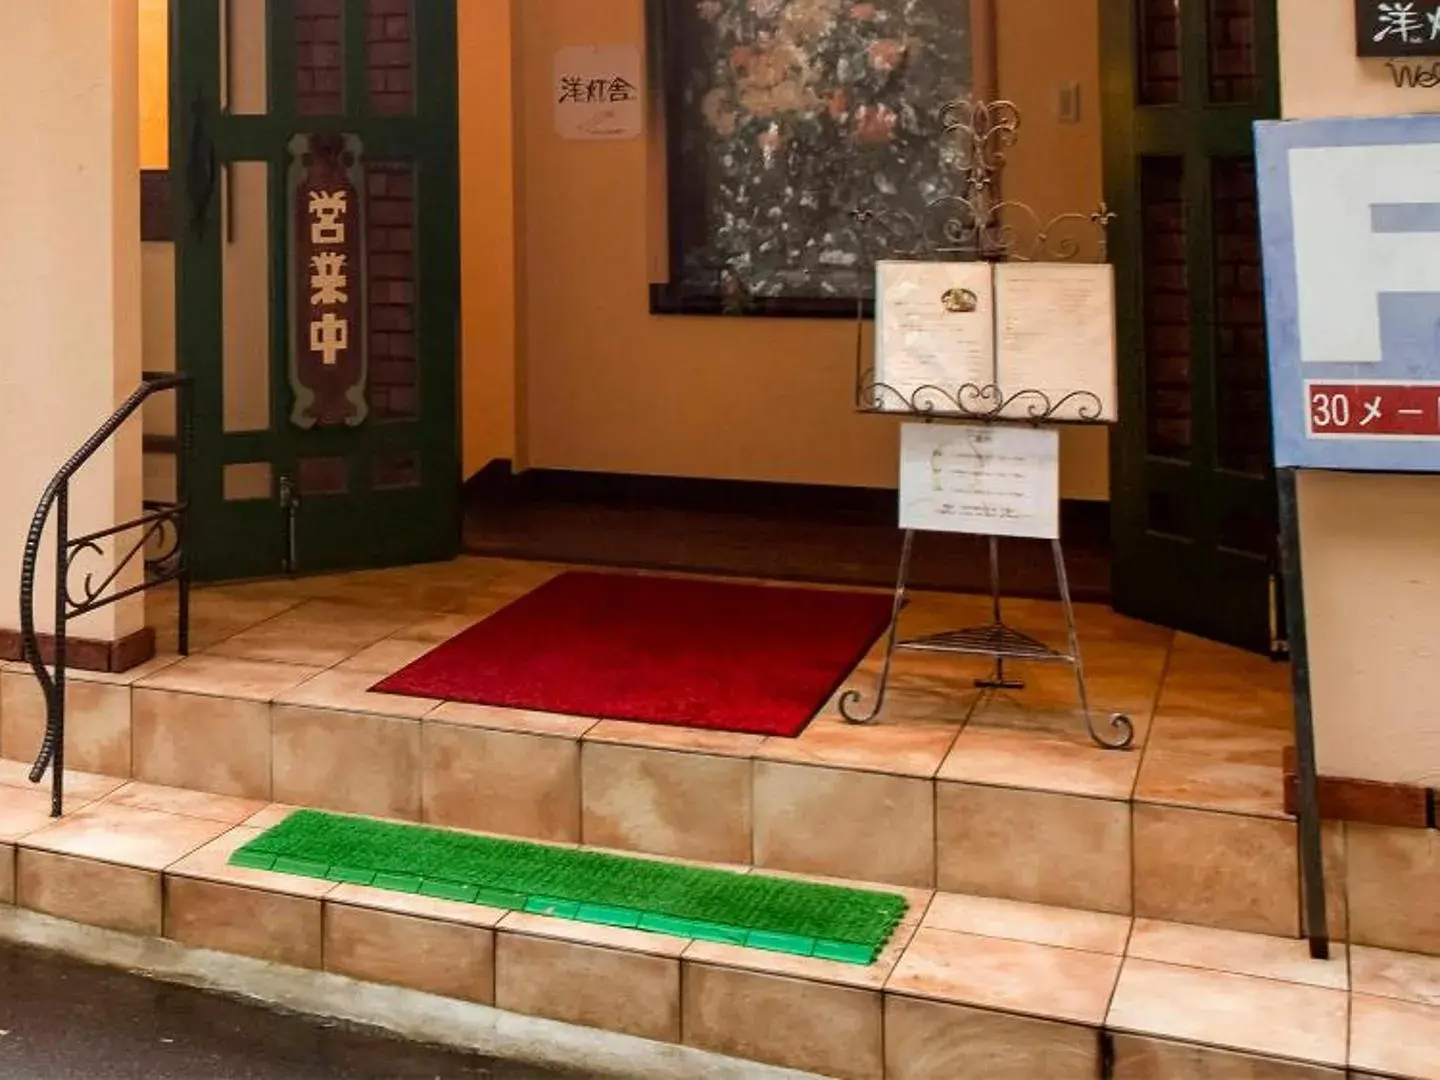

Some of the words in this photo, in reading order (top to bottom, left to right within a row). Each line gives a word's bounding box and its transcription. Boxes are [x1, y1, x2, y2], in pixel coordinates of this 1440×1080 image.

[558, 76, 638, 104] 洋灯舎
[308, 190, 348, 365] 営業中
[1312, 393, 1440, 426] 30メー
